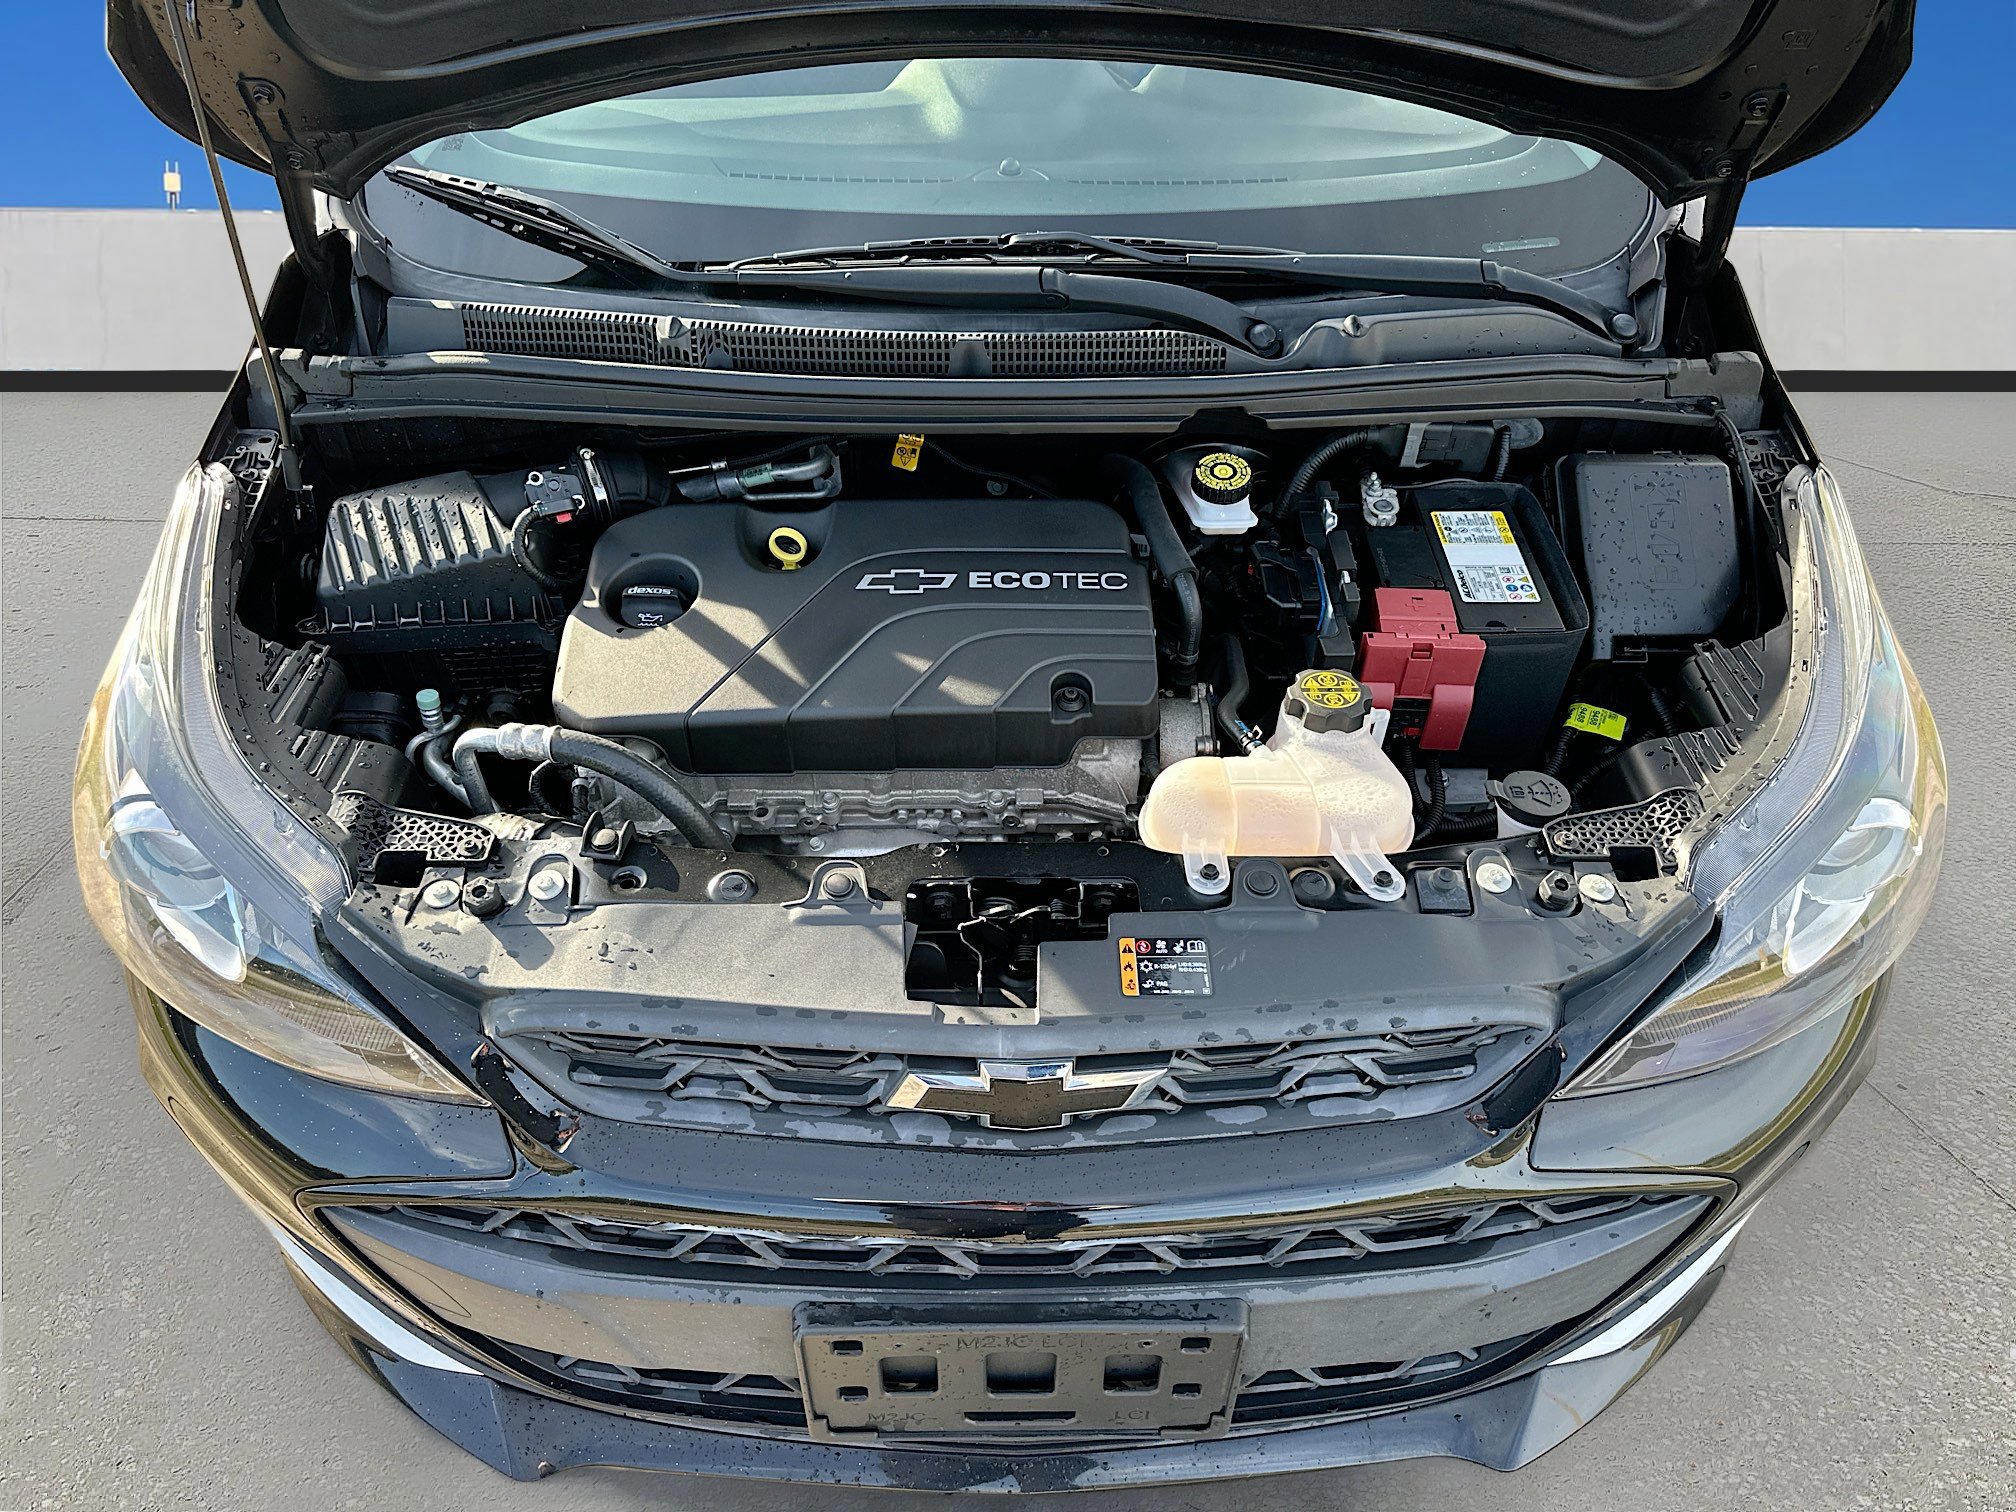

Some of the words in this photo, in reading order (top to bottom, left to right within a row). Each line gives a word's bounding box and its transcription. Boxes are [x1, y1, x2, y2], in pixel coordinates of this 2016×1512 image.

[968, 571, 1129, 590] ECOTEC
[1457, 569, 1472, 599] ACDelco
[627, 586, 672, 595] dexos
[1577, 706, 1588, 723] 9488
[1589, 710, 1601, 726] 9488
